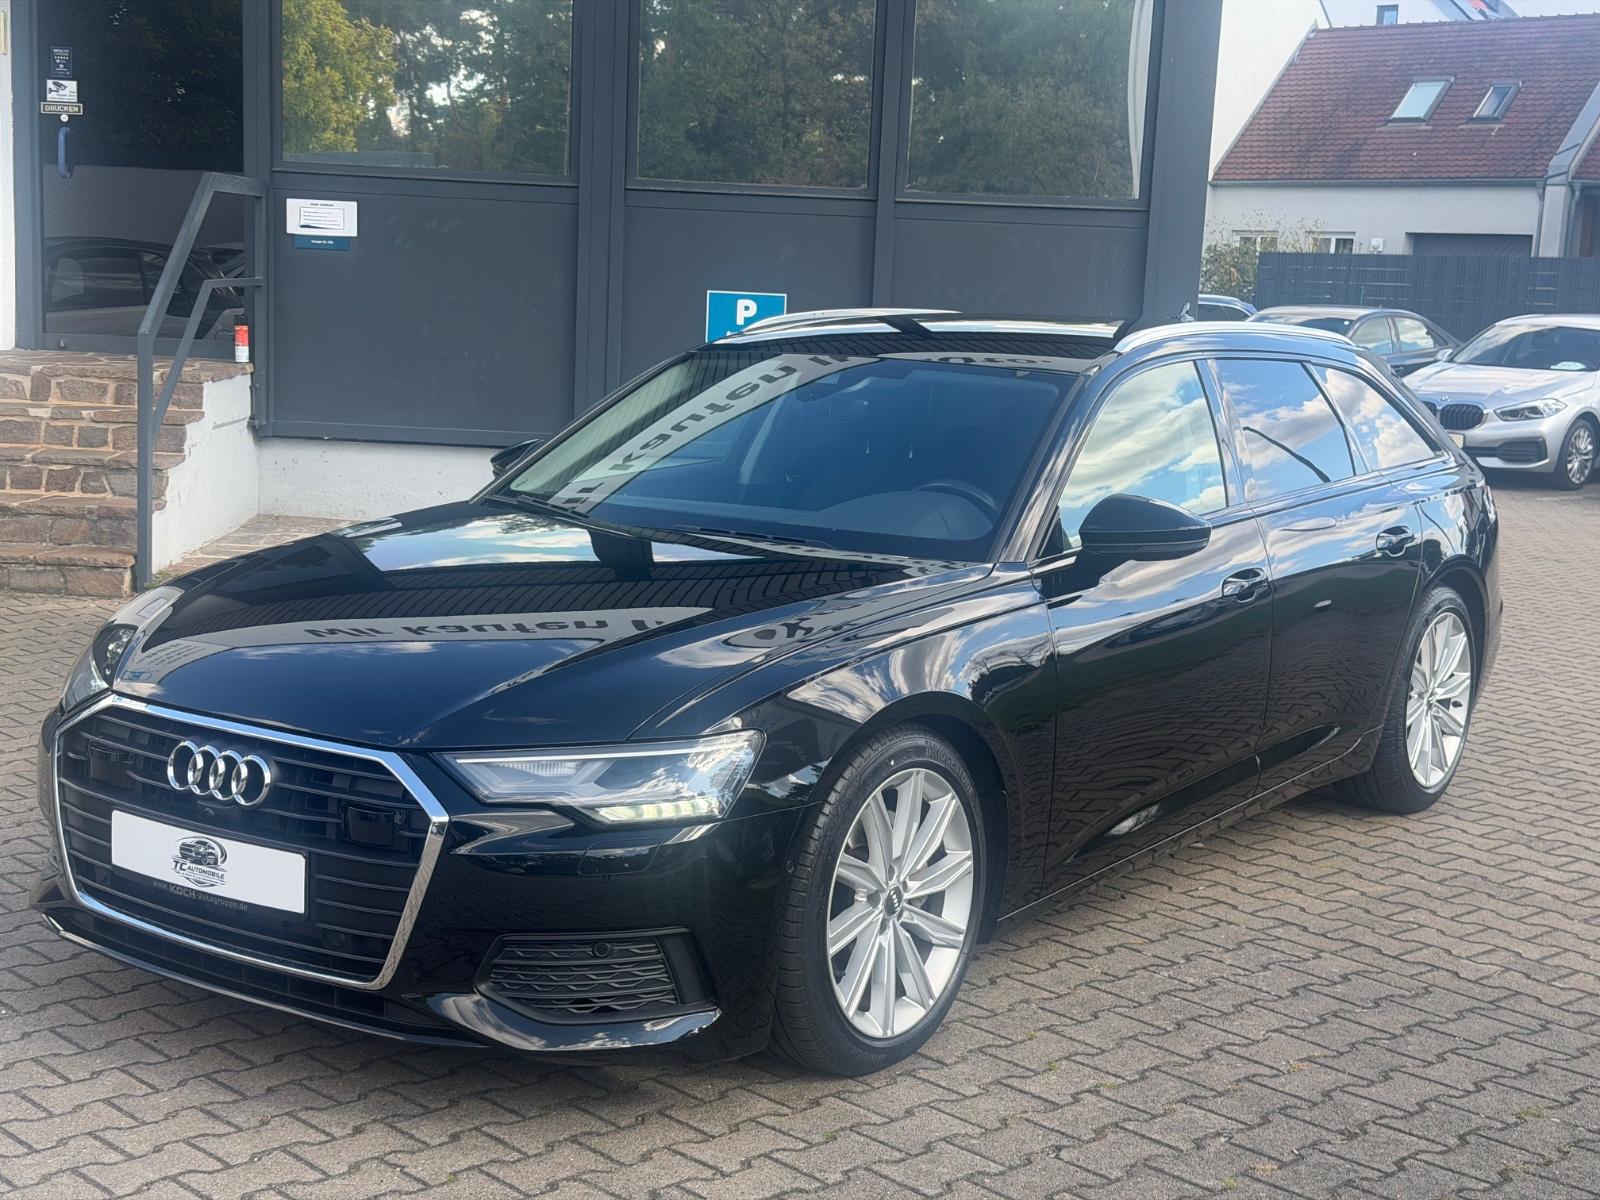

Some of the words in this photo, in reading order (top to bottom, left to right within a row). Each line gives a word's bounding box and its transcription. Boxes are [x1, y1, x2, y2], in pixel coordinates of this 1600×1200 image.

[736, 298, 758, 326] P
[172, 860, 187, 871] TC
[187, 865, 225, 880] AUTOMOBILE
